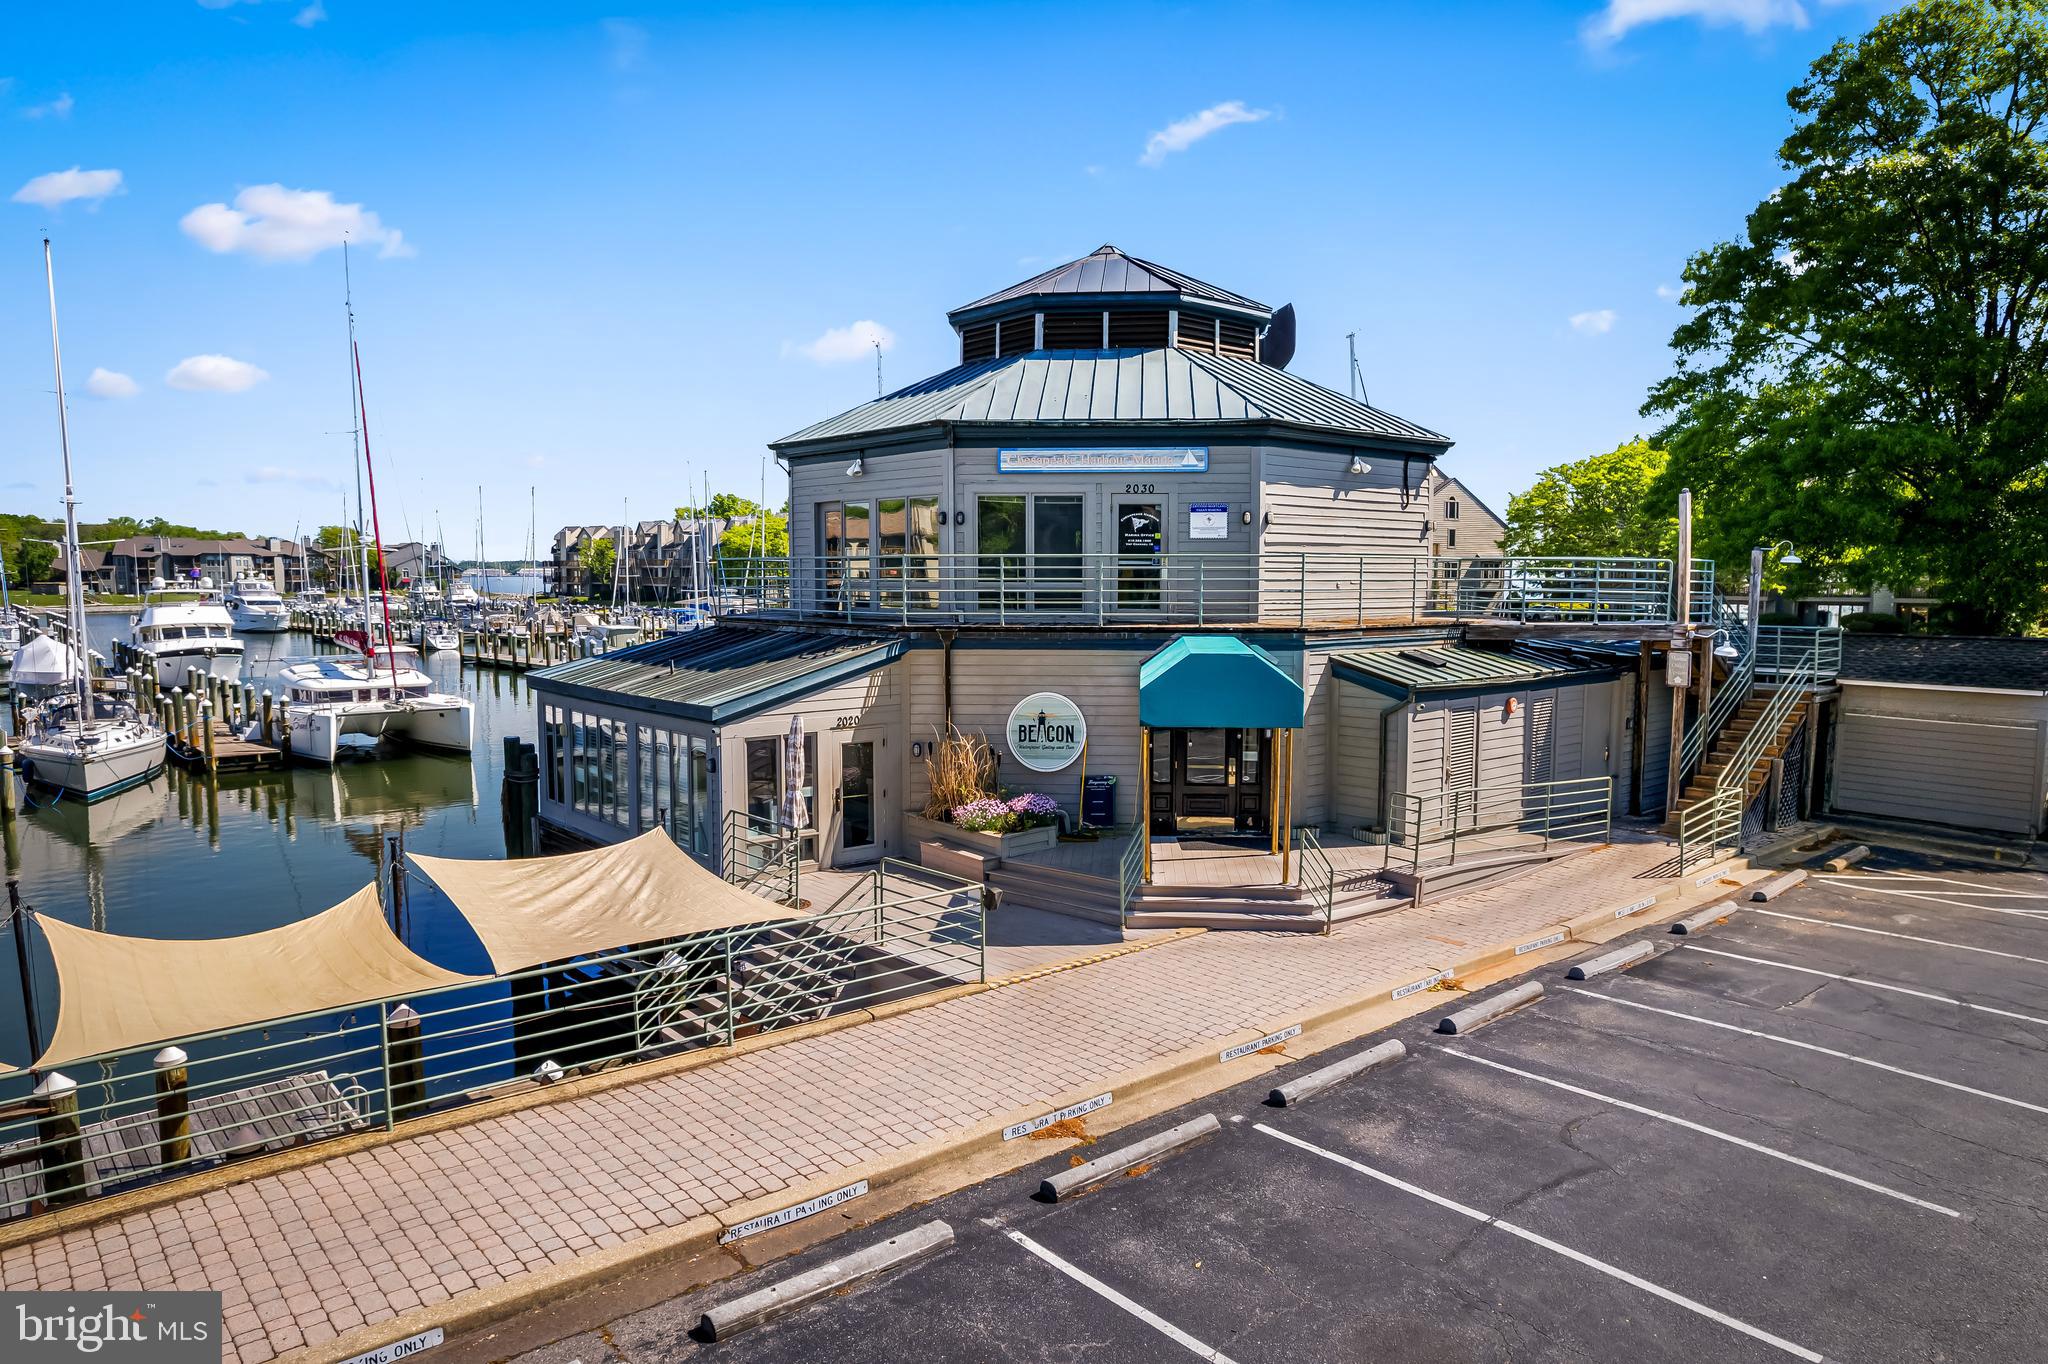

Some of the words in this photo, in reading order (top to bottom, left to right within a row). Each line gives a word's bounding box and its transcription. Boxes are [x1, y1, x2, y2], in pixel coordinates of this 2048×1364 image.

[1125, 484, 1155, 494] 2030
[836, 715, 860, 727] 2020
[1018, 724, 1075, 743] BEACON
[1225, 1041, 1261, 1059] RESTAURANT
[1261, 1033, 1283, 1046] PARKING
[1283, 1028, 1296, 1038] ONLY
[1089, 1096, 1105, 1109] ONLY
[836, 1185, 858, 1202] ONLY
[394, 1335, 427, 1358] ONLY
